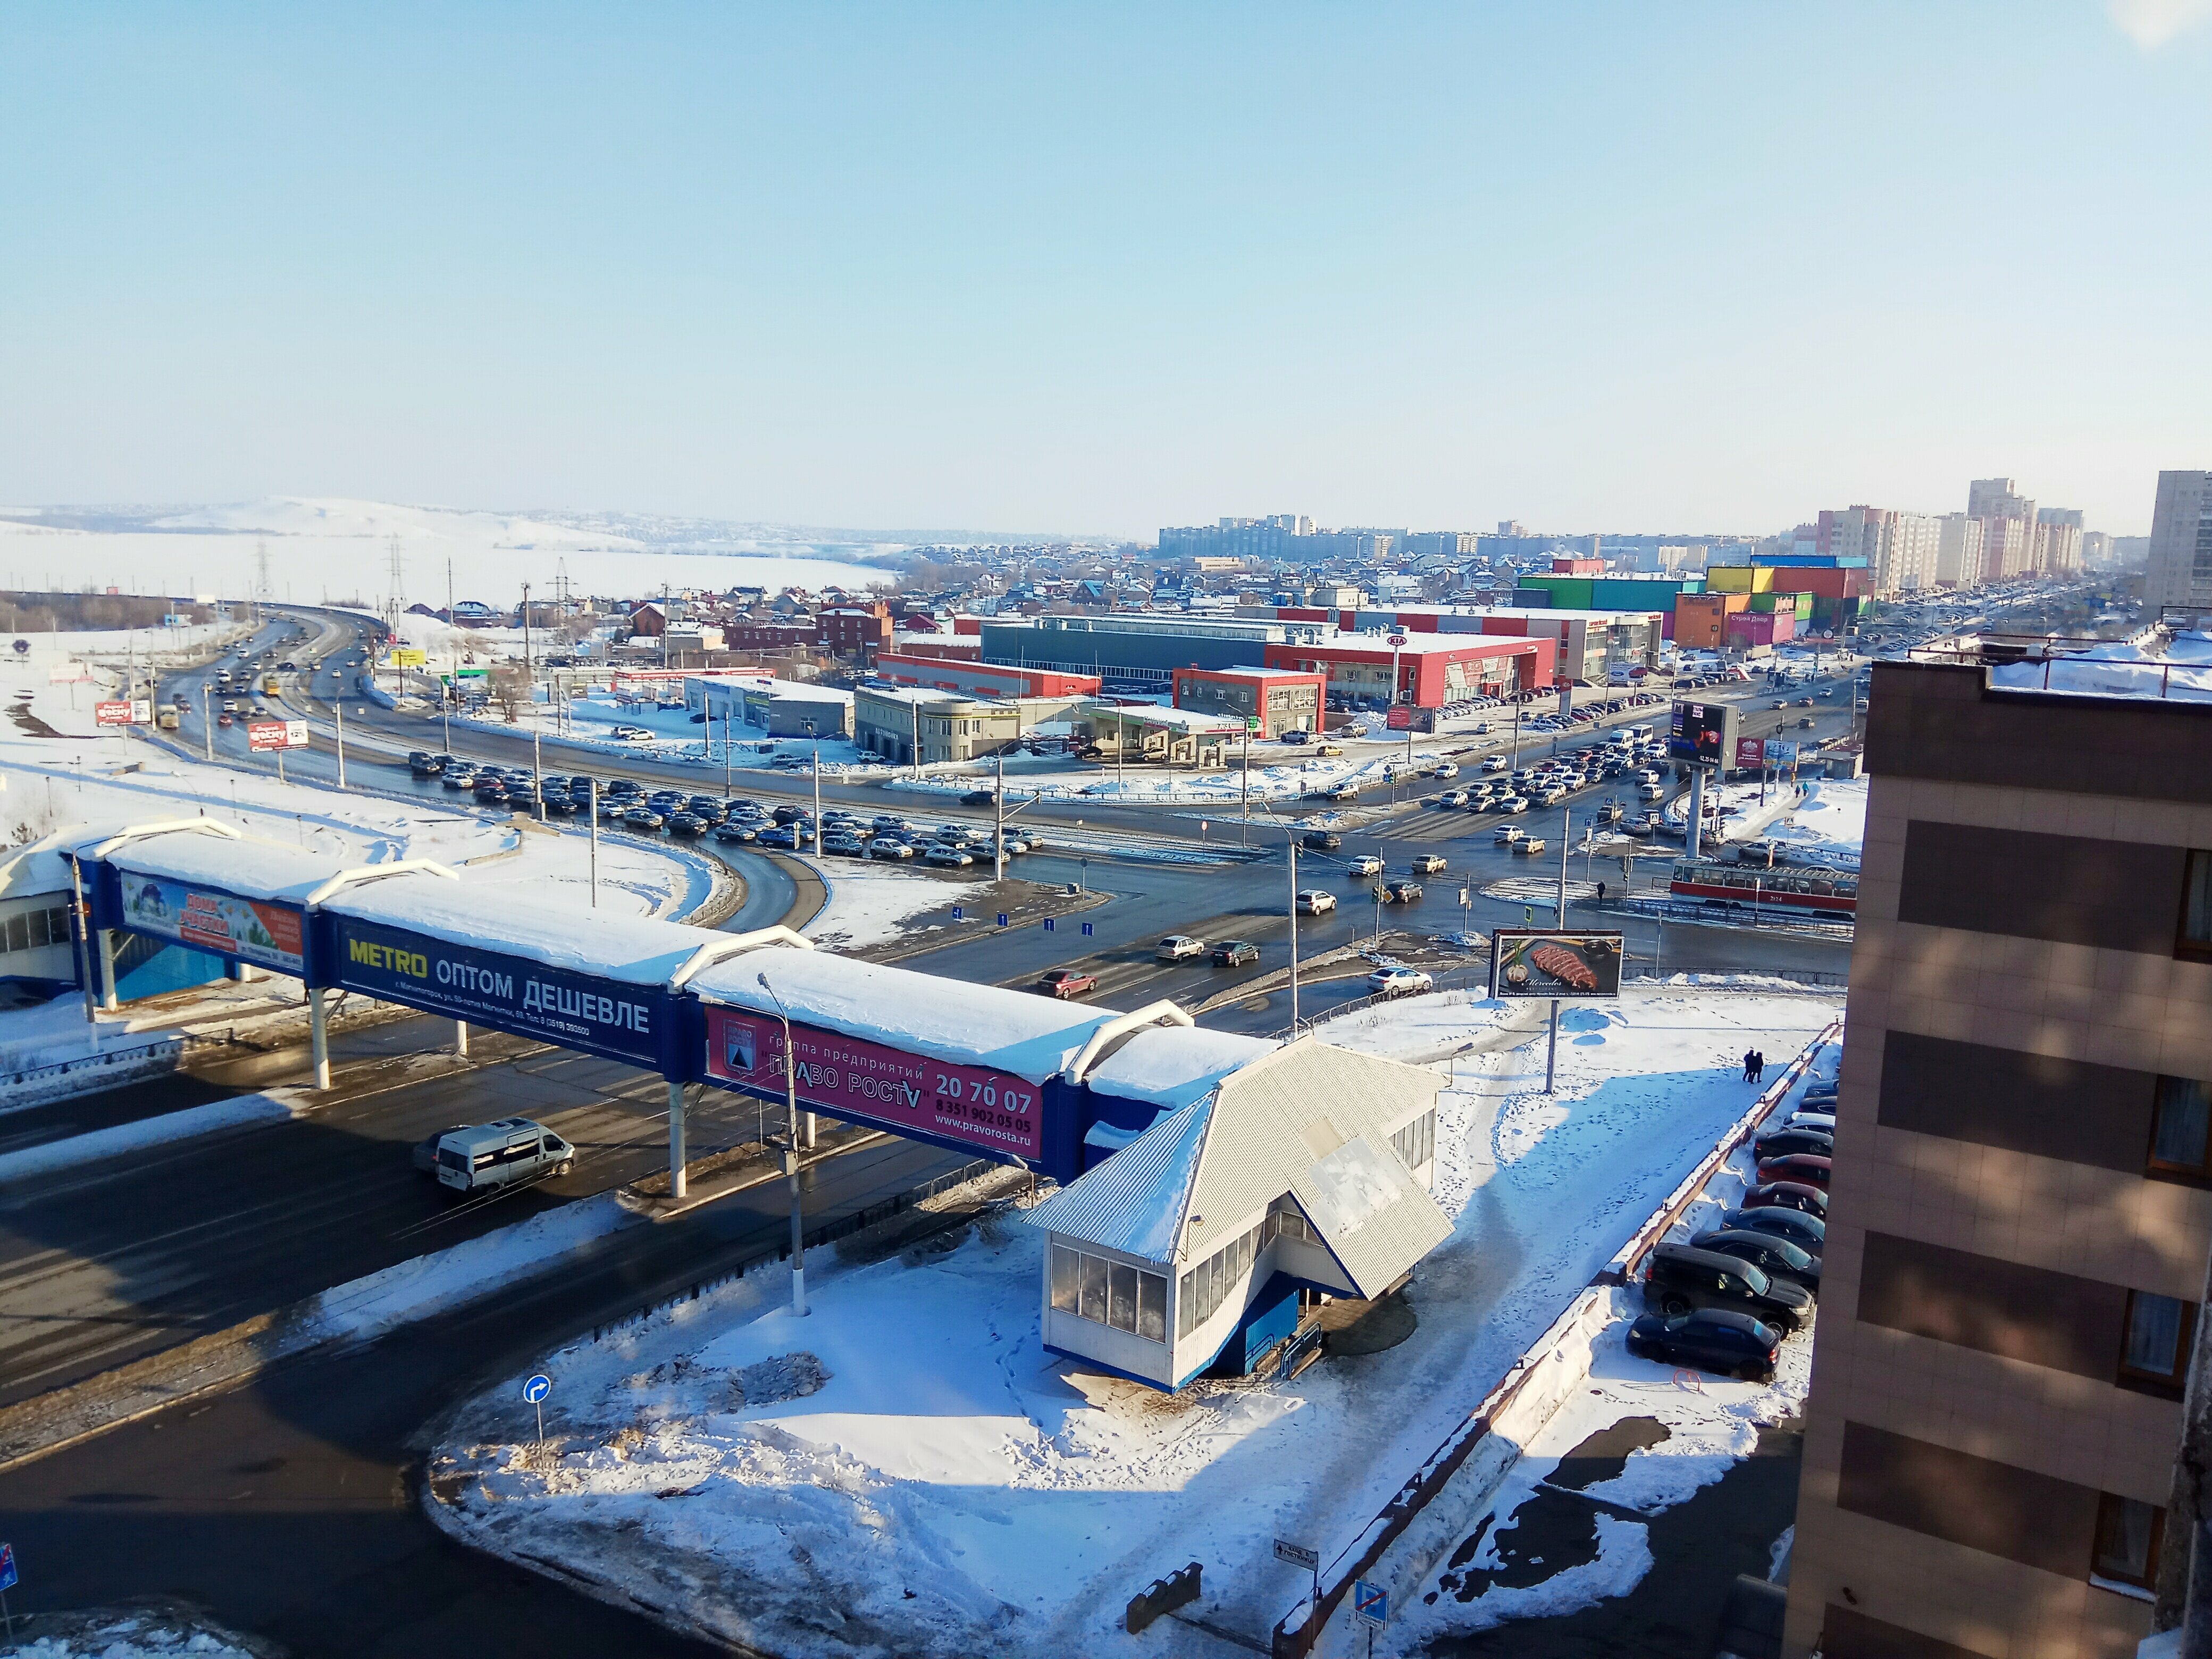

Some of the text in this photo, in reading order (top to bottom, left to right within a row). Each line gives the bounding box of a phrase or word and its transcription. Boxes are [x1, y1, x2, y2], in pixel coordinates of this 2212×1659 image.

[180, 910, 230, 935] УЧАСТКИ
[350, 939, 428, 978] METRO
[437, 960, 512, 1000] ОПТОМ
[523, 980, 650, 1034] ДЕШЕВЛЕ
[769, 1036, 923, 1080] грппа предприятий
[936, 1074, 1032, 1115] 20 70 07
[935, 1099, 1031, 1133] 8 351 902 05 05
[935, 1115, 1031, 1146] www.pravorosta.ru
[1283, 1550, 1315, 1565] ГОСТИНИЦУ
